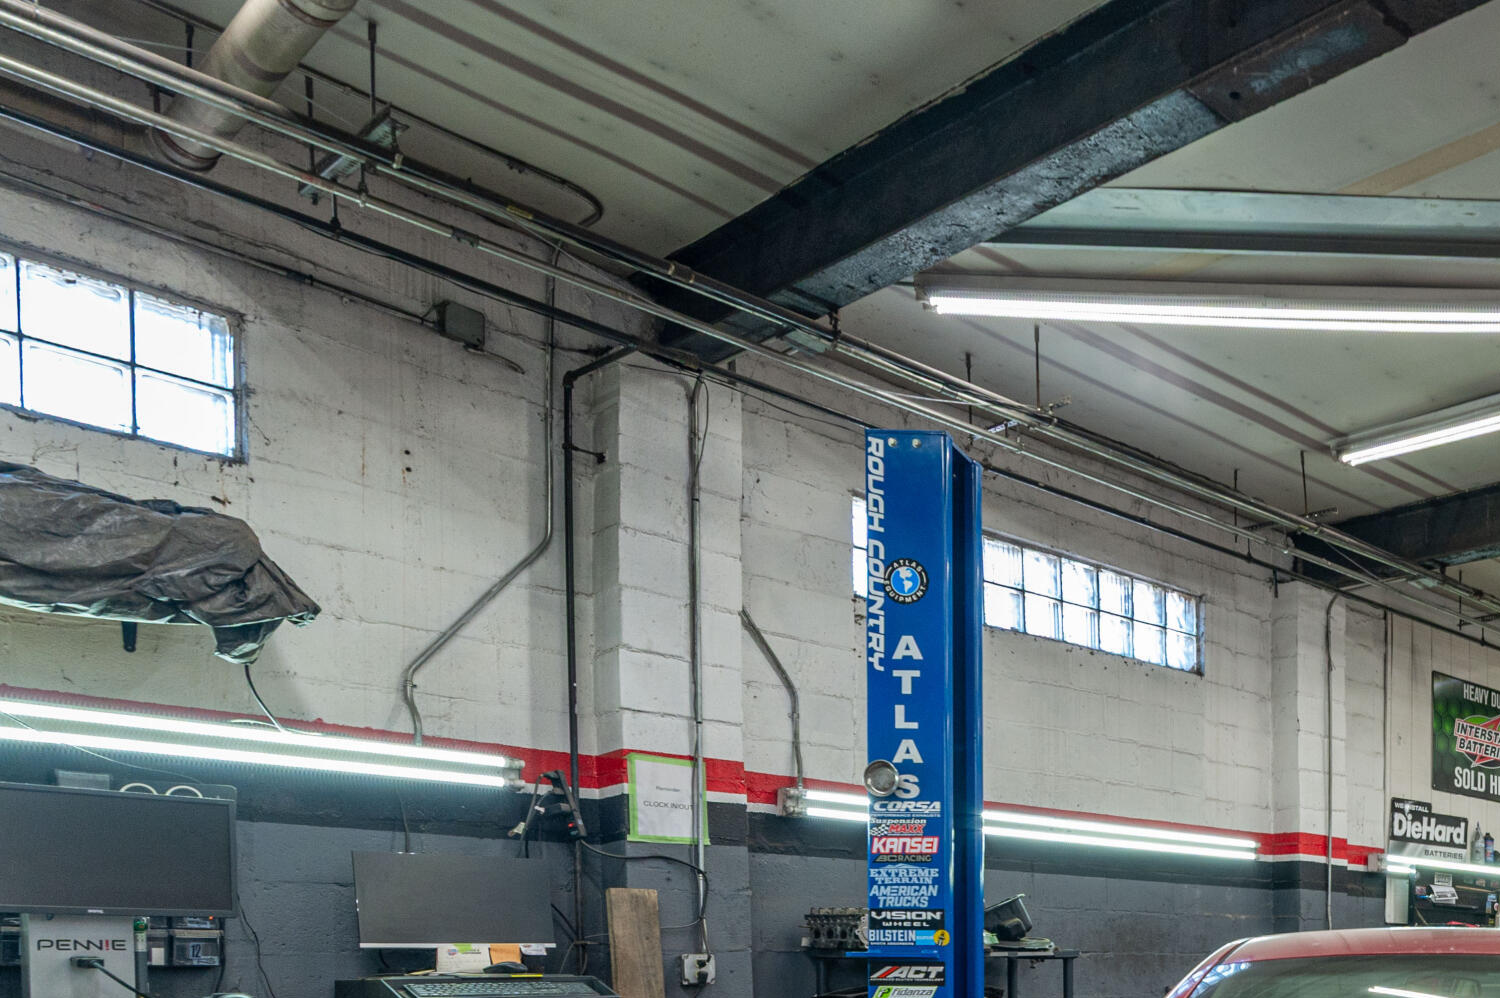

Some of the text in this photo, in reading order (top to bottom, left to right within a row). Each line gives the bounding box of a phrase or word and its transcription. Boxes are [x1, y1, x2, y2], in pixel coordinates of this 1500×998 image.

[867, 436, 885, 672] ROUGH COUNTRY
[893, 560, 922, 572] ATLAS
[1463, 682, 1489, 706] HEAVY
[892, 635, 924, 799] ATLAS
[1454, 766, 1486, 792] SOLD
[643, 800, 670, 809] CLOCK
[873, 801, 941, 813] CORSA
[889, 824, 925, 833] MAXX
[1393, 811, 1466, 845] DieHard
[872, 836, 939, 854] KANSEI
[1424, 849, 1464, 860] BATTERIES
[869, 868, 940, 878] EXTREME
[875, 877, 933, 885] TERRAIN
[869, 885, 939, 897] AMERICAN
[877, 896, 929, 908] TRUCKS
[870, 911, 942, 920] VISION
[869, 929, 916, 942] BILSTEIN
[885, 965, 945, 979] ACT
